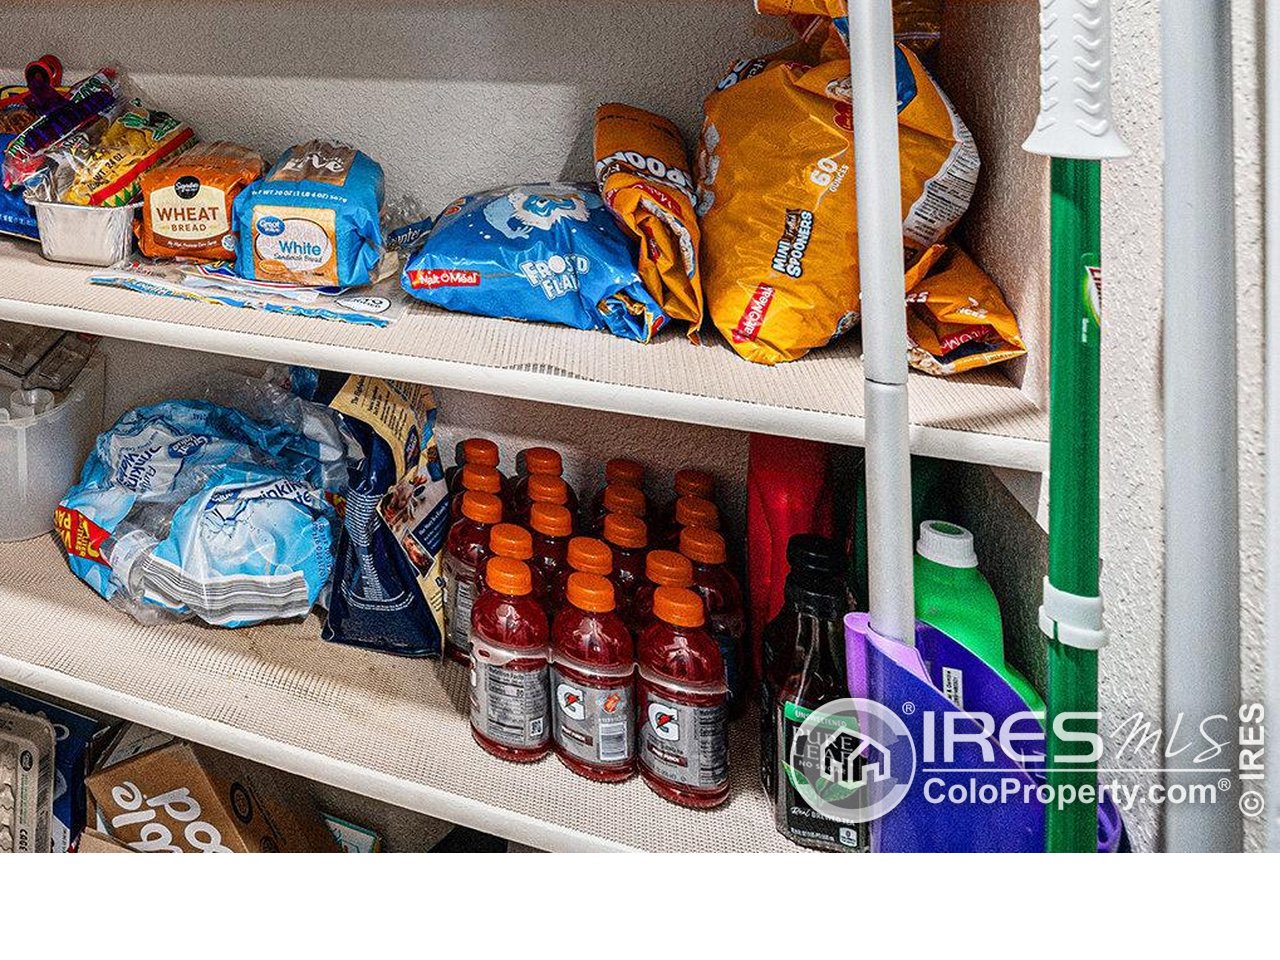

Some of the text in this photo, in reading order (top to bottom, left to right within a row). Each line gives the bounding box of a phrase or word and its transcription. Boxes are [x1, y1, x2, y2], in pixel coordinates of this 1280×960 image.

[809, 157, 840, 187] 60
[156, 206, 220, 221] WHEAT
[171, 222, 207, 233] BREAD
[279, 240, 321, 256] White
[773, 239, 793, 272] MINI
[786, 210, 813, 278] SPOONERS
[19, 828, 28, 852] CAGE
